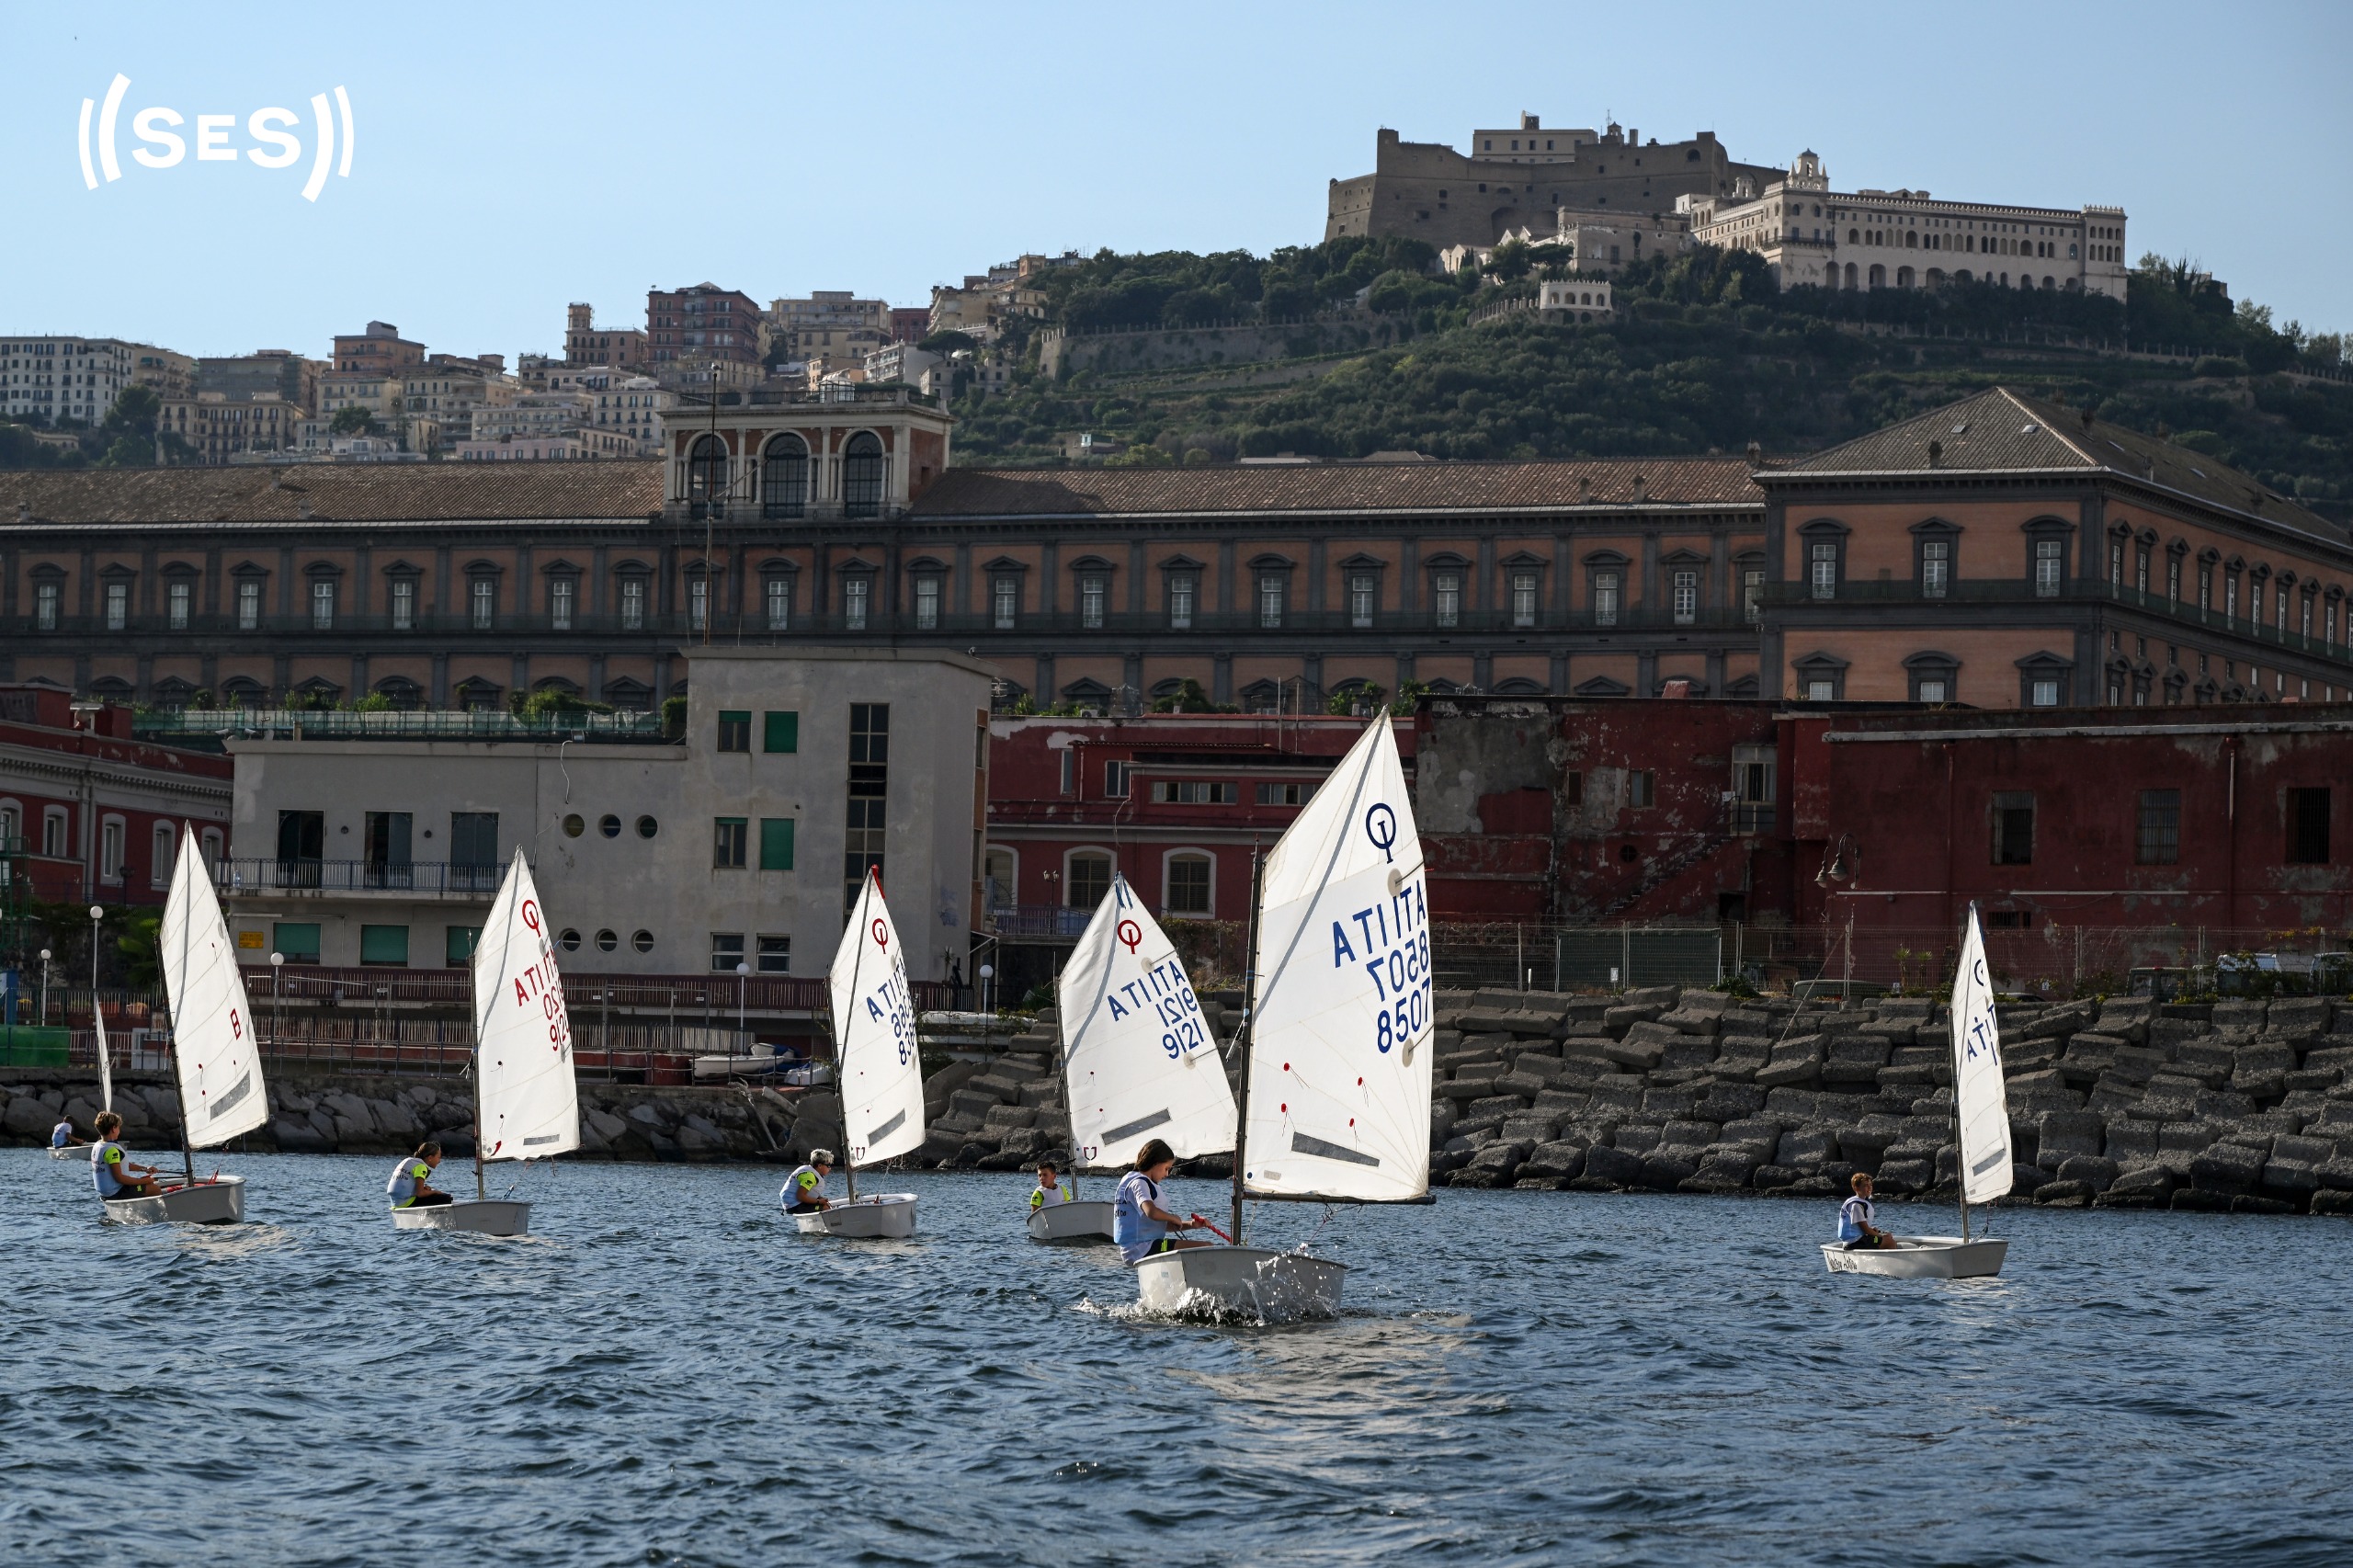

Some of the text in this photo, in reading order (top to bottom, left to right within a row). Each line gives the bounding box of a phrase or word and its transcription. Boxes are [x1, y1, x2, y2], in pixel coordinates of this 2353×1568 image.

[1392, 879, 1427, 939] ITA
[1147, 960, 1187, 997] ITA
[1162, 1017, 1205, 1060] 9121
[1377, 976, 1431, 1054] 8507
